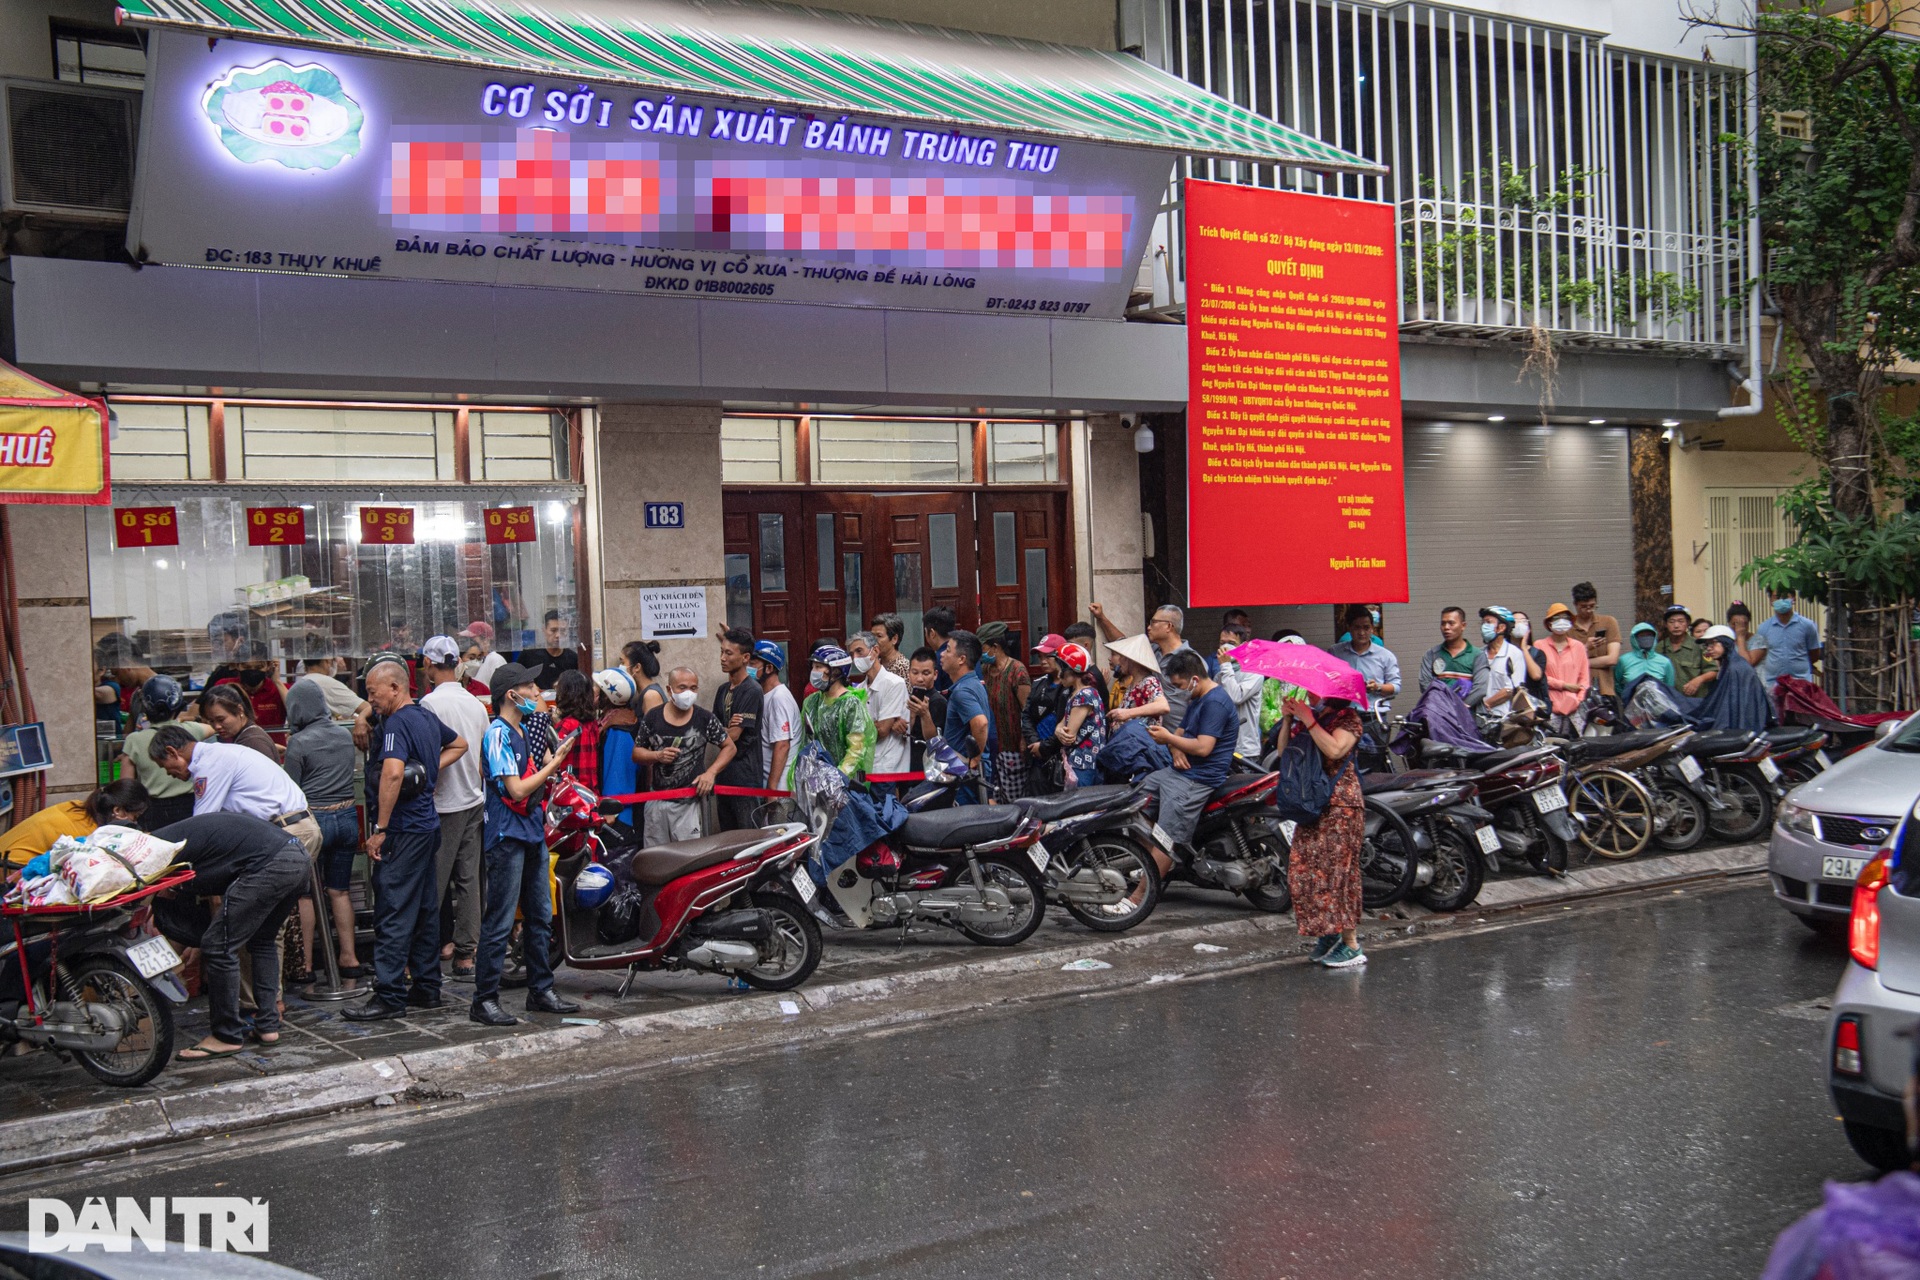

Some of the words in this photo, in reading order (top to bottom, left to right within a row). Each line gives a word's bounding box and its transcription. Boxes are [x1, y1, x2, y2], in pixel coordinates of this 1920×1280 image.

[482, 82, 534, 118] CƠ
[544, 84, 594, 124] SỞ
[630, 95, 704, 137] SẢN
[804, 116, 892, 156] BÁNH
[1006, 141, 1060, 173] THU
[1199, 225, 1218, 236] Trích
[1220, 227, 1240, 240] Quyết
[1242, 230, 1258, 242] định
[1259, 232, 1268, 242] số
[1283, 235, 1293, 247] Bộ
[1294, 236, 1306, 248] Xây
[1308, 238, 1325, 251] dựng
[1326, 241, 1342, 252] ngày
[278, 253, 326, 272] THỤY
[333, 256, 382, 272] KHUÊ
[395, 235, 440, 255] ĐẢM
[446, 239, 486, 256] BẢO
[494, 241, 545, 261] CHẤT
[551, 250, 615, 268] LƯỢNG
[630, 255, 694, 271] HƯƠNG
[700, 260, 716, 276] VỊ
[723, 254, 750, 274] CỔ
[754, 263, 788, 277] XƯA
[802, 267, 868, 283] THƯỢNG
[874, 268, 896, 284] ĐẾ
[901, 272, 928, 286] HÀI
[934, 274, 976, 288] LÒNG
[1267, 257, 1296, 275] QUYẾT
[1300, 263, 1323, 279] ĐỊNH
[644, 276, 689, 292] ĐKKD
[695, 278, 774, 296] 01B8002605
[1039, 300, 1060, 312] 823
[1063, 302, 1090, 313] 0797
[122, 512, 136, 526] Ô
[254, 511, 266, 526] Ô
[366, 510, 378, 524] Ô
[490, 511, 502, 526] Ô
[650, 506, 678, 525] 183
[140, 528, 152, 542] 1
[270, 527, 284, 542] 2
[381, 526, 394, 541] 3
[504, 526, 516, 540] 4
[1330, 556, 1354, 570] Nguyễn
[1370, 558, 1385, 567] Nam
[644, 592, 658, 602] QUÝ
[661, 592, 686, 600] KHÁCH
[688, 591, 703, 599] ĐẾN
[654, 612, 668, 620] XẾP
[670, 610, 690, 619] HÀNG
